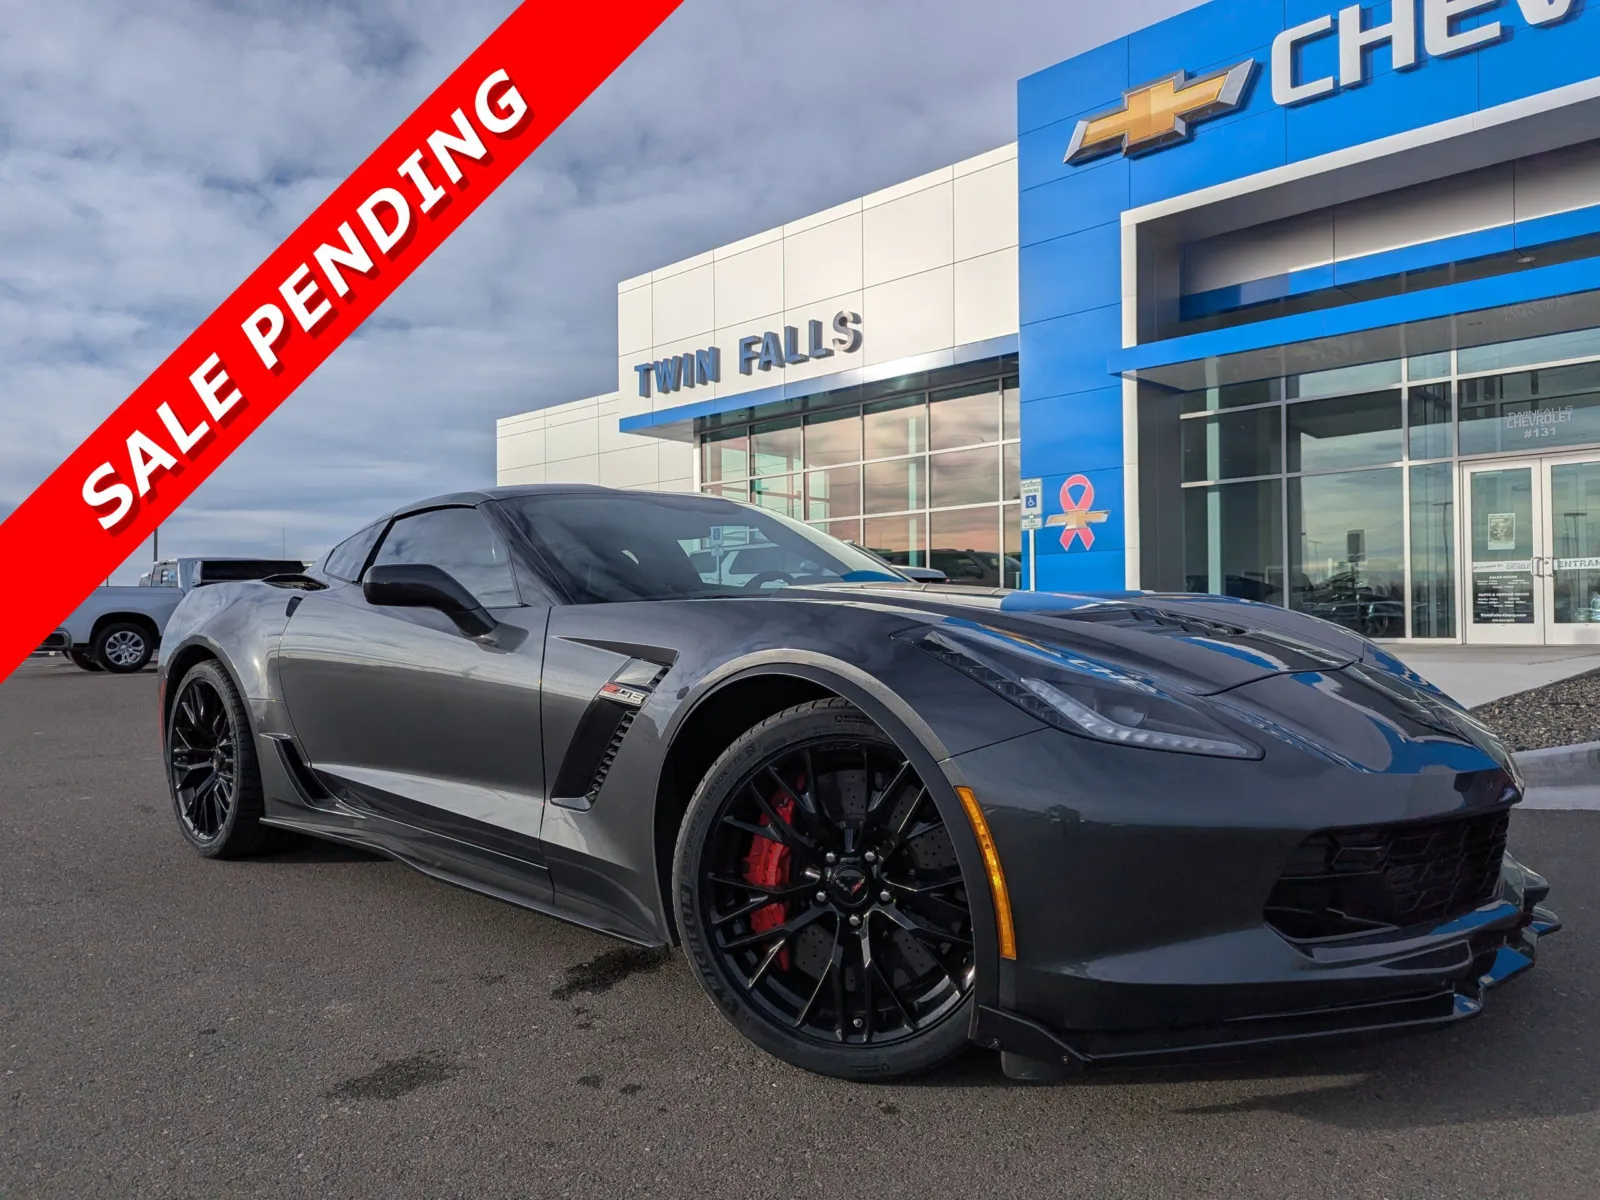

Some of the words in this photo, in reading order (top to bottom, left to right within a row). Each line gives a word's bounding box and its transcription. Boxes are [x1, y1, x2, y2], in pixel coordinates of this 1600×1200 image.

[634, 346, 721, 398] TWIN
[738, 310, 863, 376] FALLS
[1506, 411, 1573, 429] CHEVROLET
[1524, 426, 1556, 439] #131
